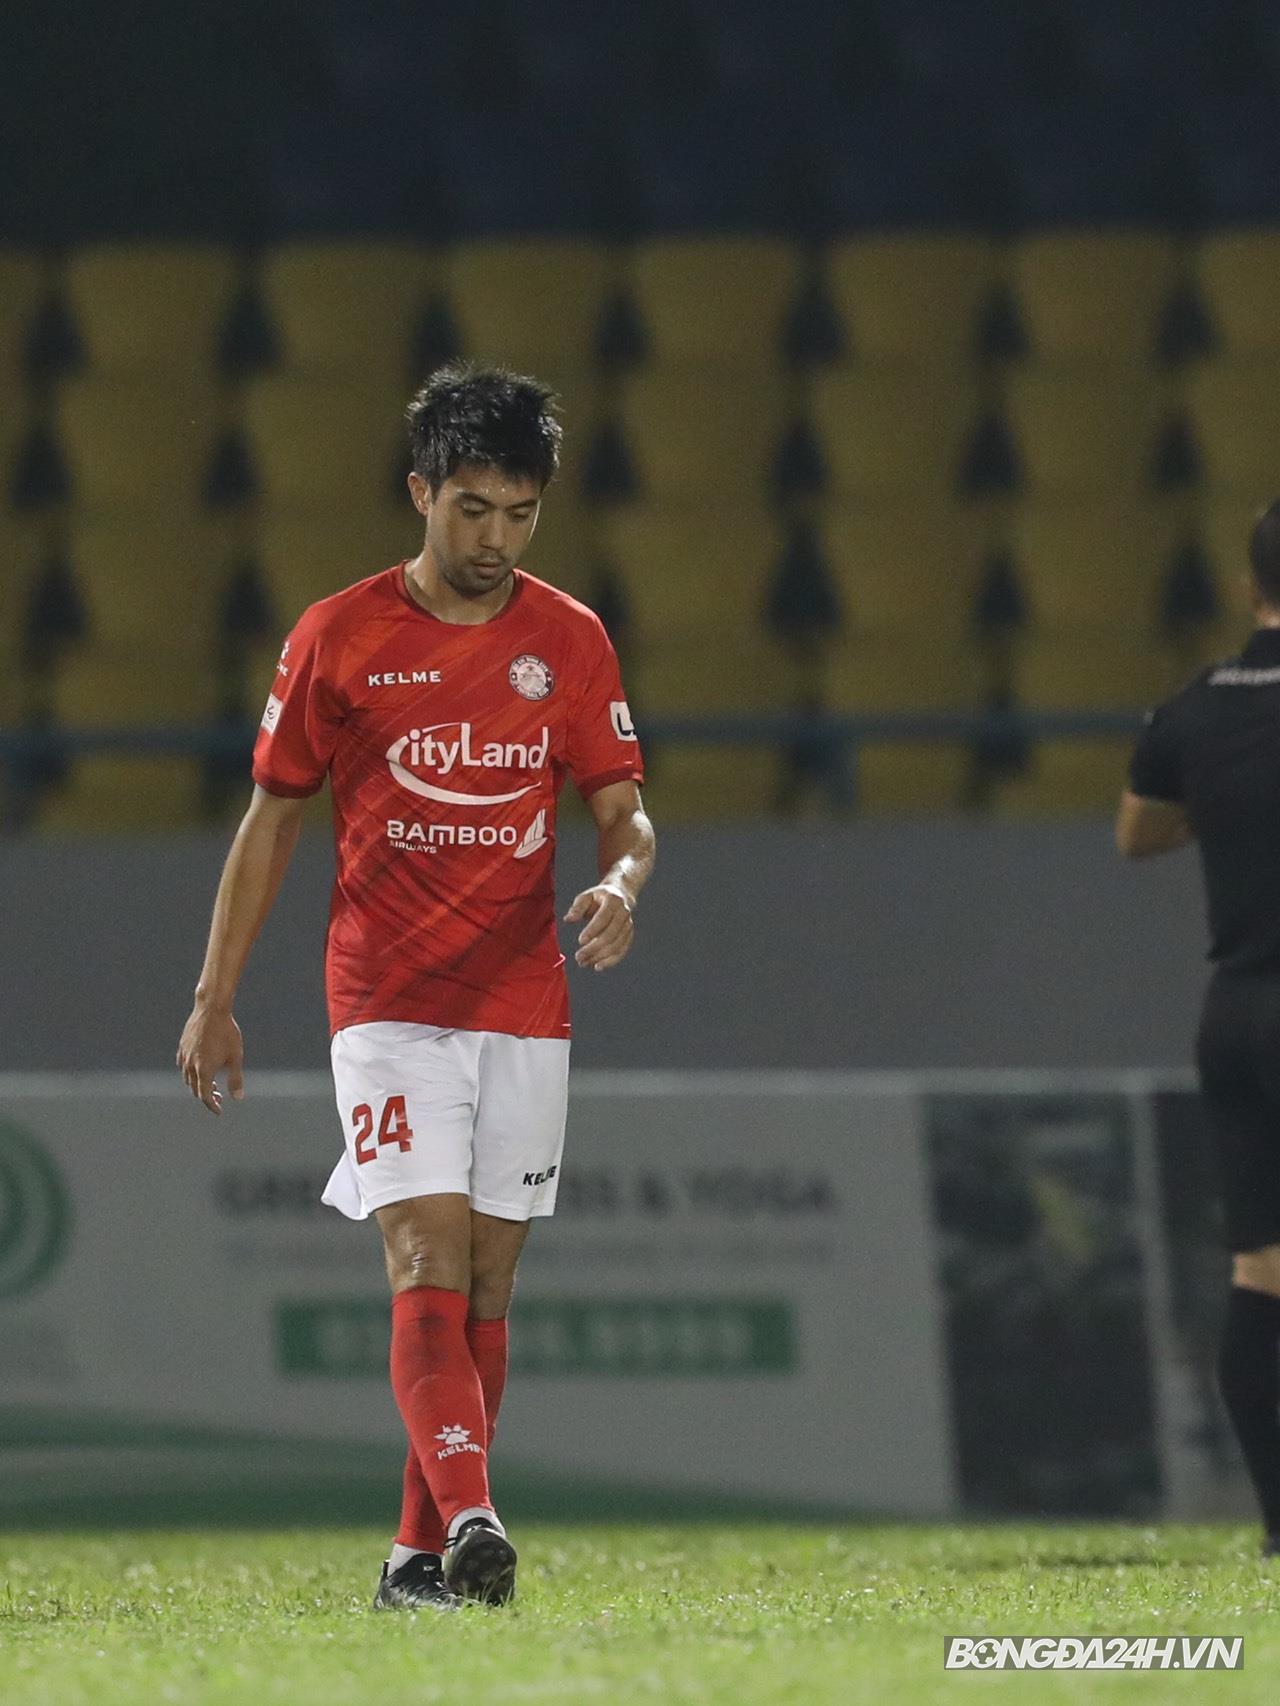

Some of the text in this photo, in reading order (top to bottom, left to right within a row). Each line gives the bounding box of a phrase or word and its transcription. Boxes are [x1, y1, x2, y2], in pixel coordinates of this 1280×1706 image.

[367, 670, 442, 687] KELME
[386, 820, 517, 846] BAMBOO
[389, 840, 437, 854] AIRWAYS
[353, 1095, 414, 1166] 24
[437, 1443, 481, 1460] KELME
